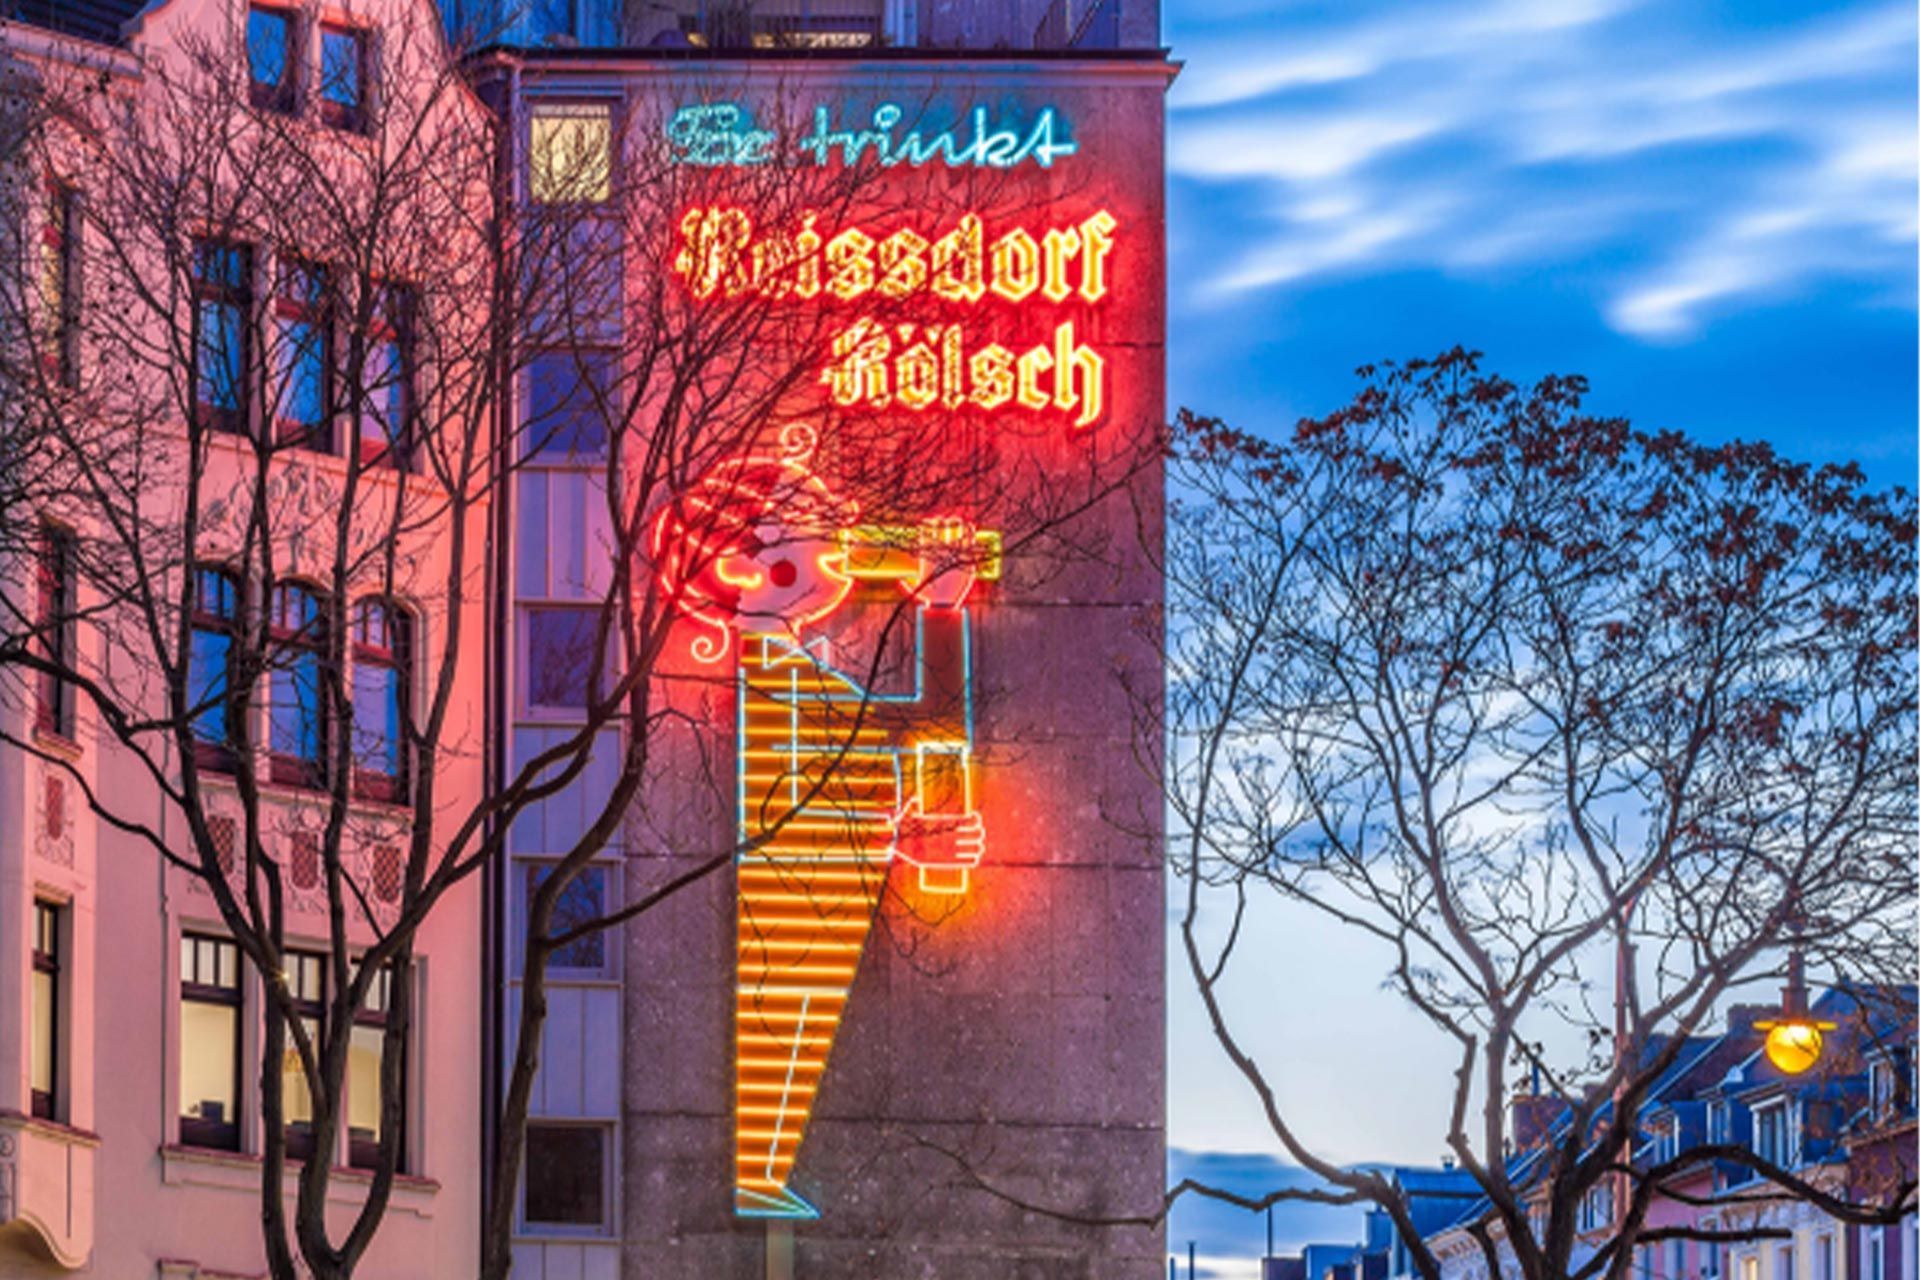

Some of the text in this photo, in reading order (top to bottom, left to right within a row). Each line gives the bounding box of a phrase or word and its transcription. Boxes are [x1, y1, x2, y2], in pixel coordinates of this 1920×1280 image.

[802, 104, 1078, 167] trinkt
[674, 206, 1117, 302] Reissdorf
[821, 316, 1104, 427] Kölsch
